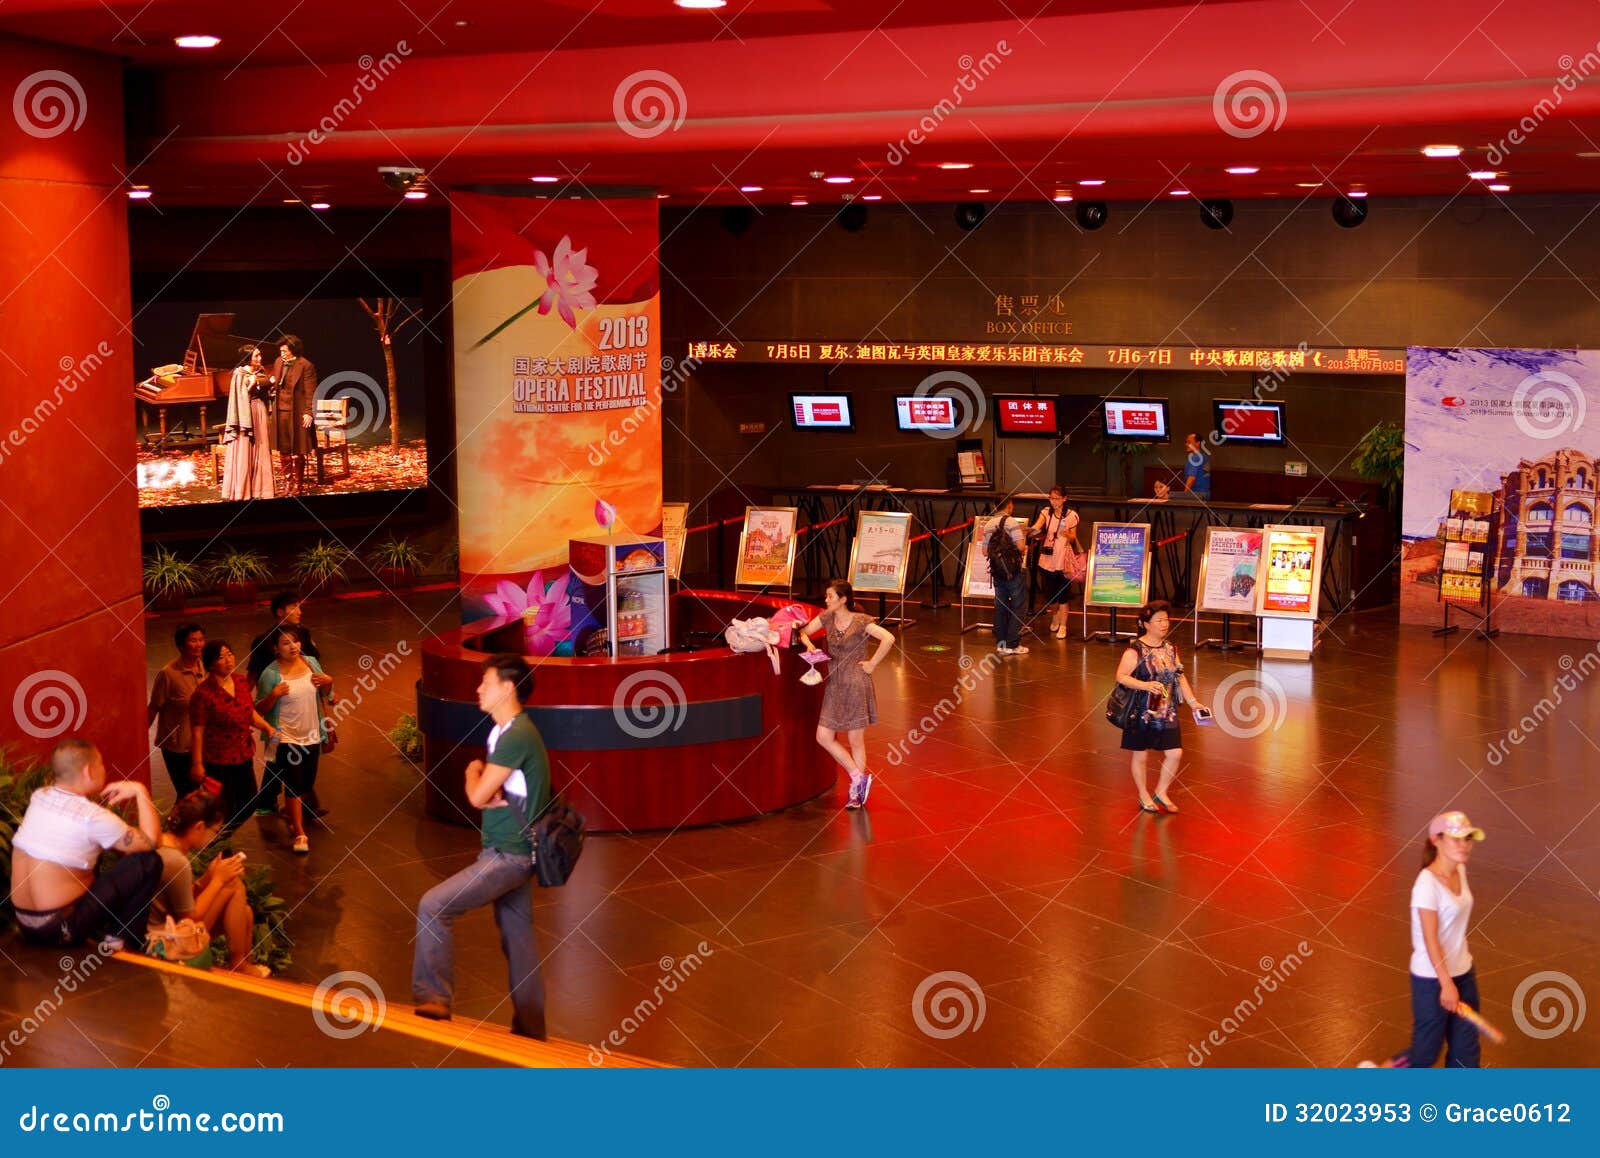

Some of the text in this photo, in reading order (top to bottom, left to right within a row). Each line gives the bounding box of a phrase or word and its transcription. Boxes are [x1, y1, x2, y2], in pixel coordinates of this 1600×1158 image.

[994, 294, 1069, 317] 售票处
[599, 316, 649, 351] 2013
[986, 321, 1073, 335] BOX OFFICE
[512, 352, 648, 377] 国家大剧院歌剧节
[688, 342, 738, 360] 音乐会
[767, 344, 811, 360] 7月5日
[1108, 349, 1172, 366] 7月6-7日
[513, 372, 647, 403] OPERA FESTIVAL
